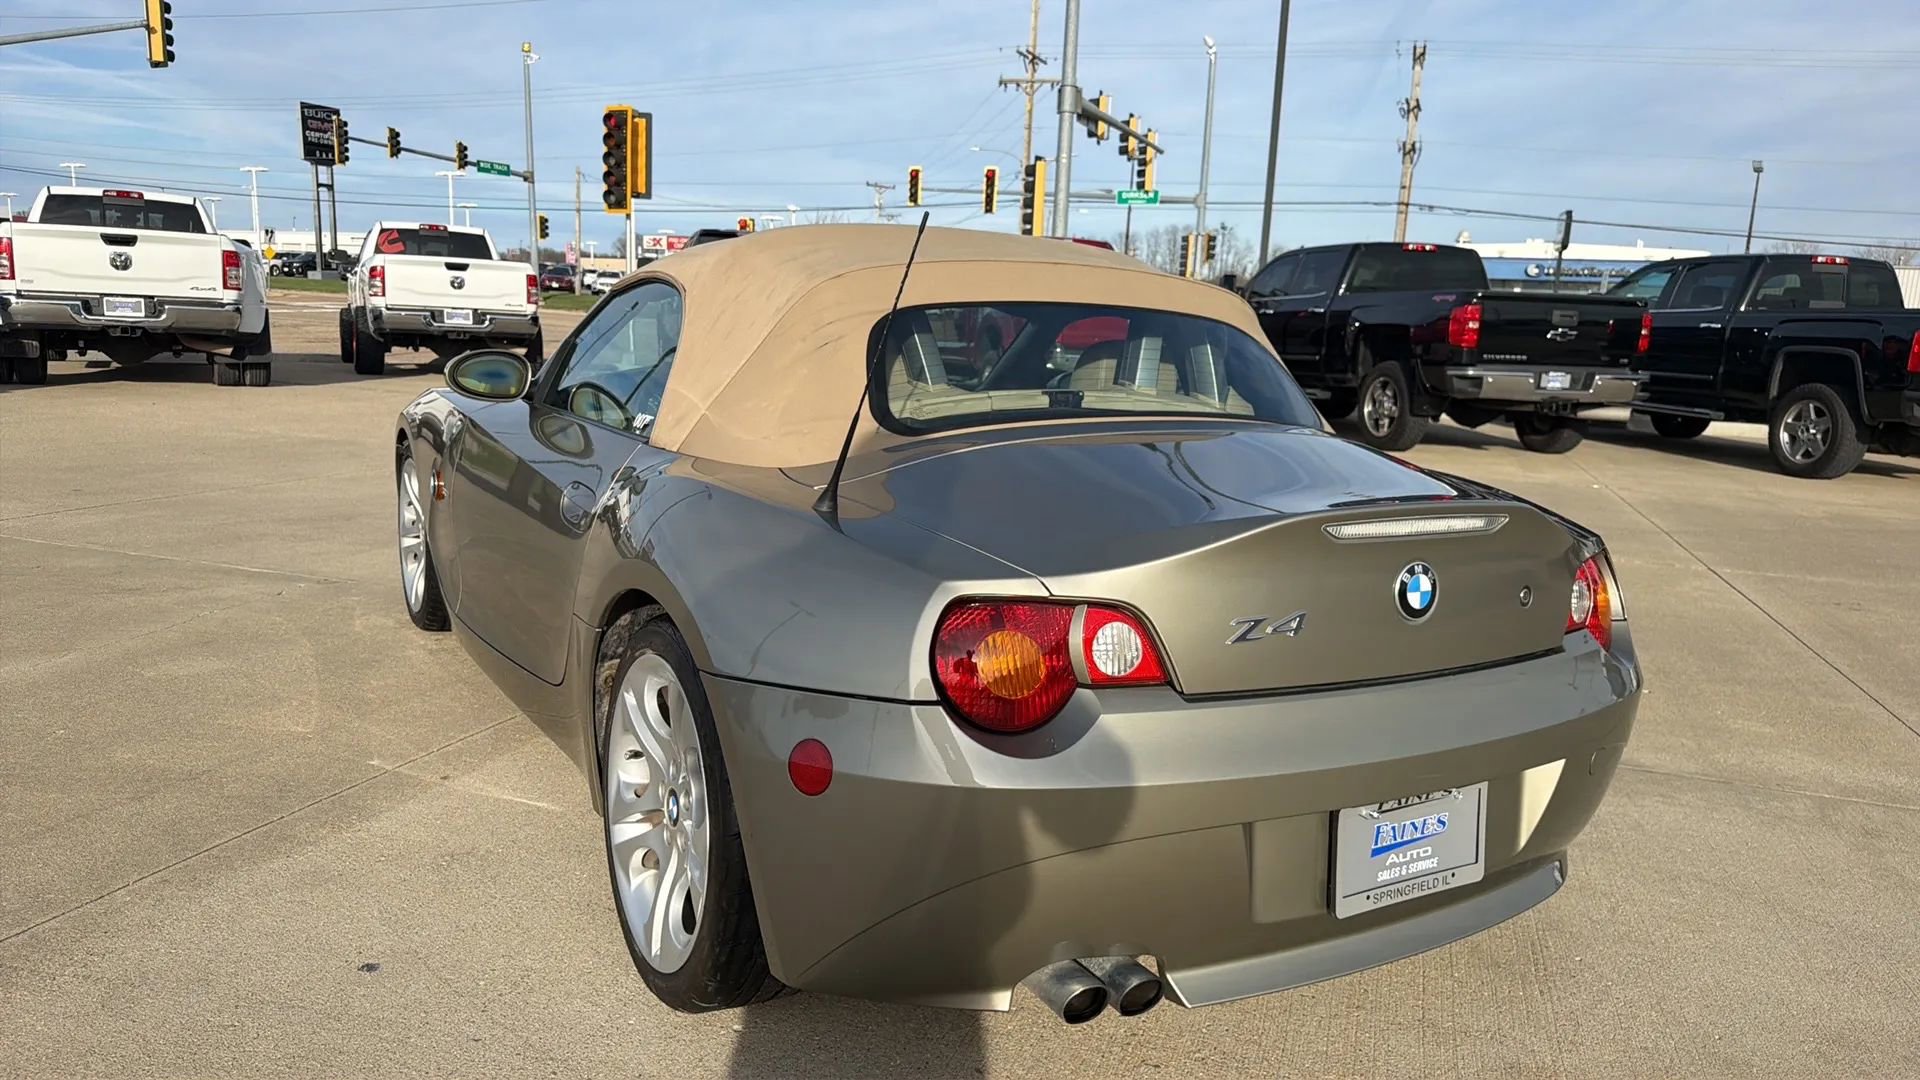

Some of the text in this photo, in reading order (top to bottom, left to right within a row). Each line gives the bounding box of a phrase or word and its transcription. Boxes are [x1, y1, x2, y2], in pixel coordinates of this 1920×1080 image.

[1401, 564, 1435, 585] BMW
[1225, 609, 1308, 645] Z4
[1371, 811, 1449, 849] FAINE'S
[1377, 857, 1439, 882] SALES & SERVICE
[1385, 846, 1432, 866] AUTO
[1372, 875, 1451, 905] SPRINGFIELD IL
